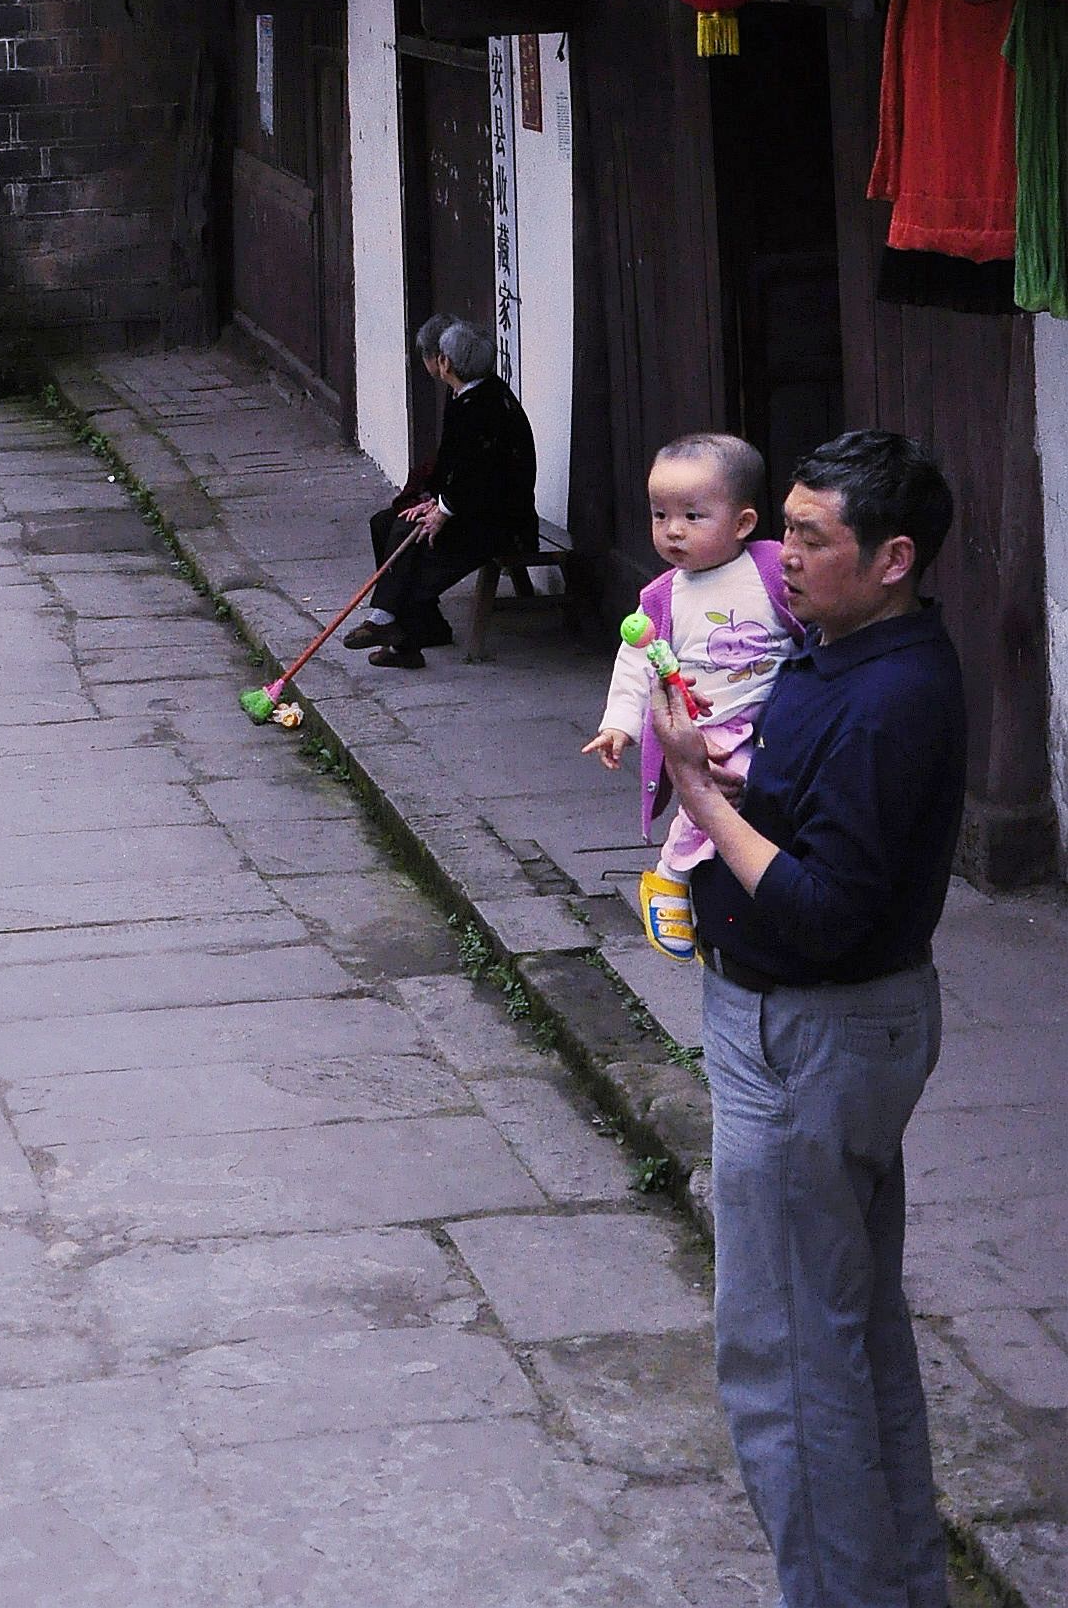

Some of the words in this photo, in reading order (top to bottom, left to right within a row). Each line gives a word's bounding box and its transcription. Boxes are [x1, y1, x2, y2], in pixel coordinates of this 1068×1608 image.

[492, 35, 514, 386] 安县收藏家协
